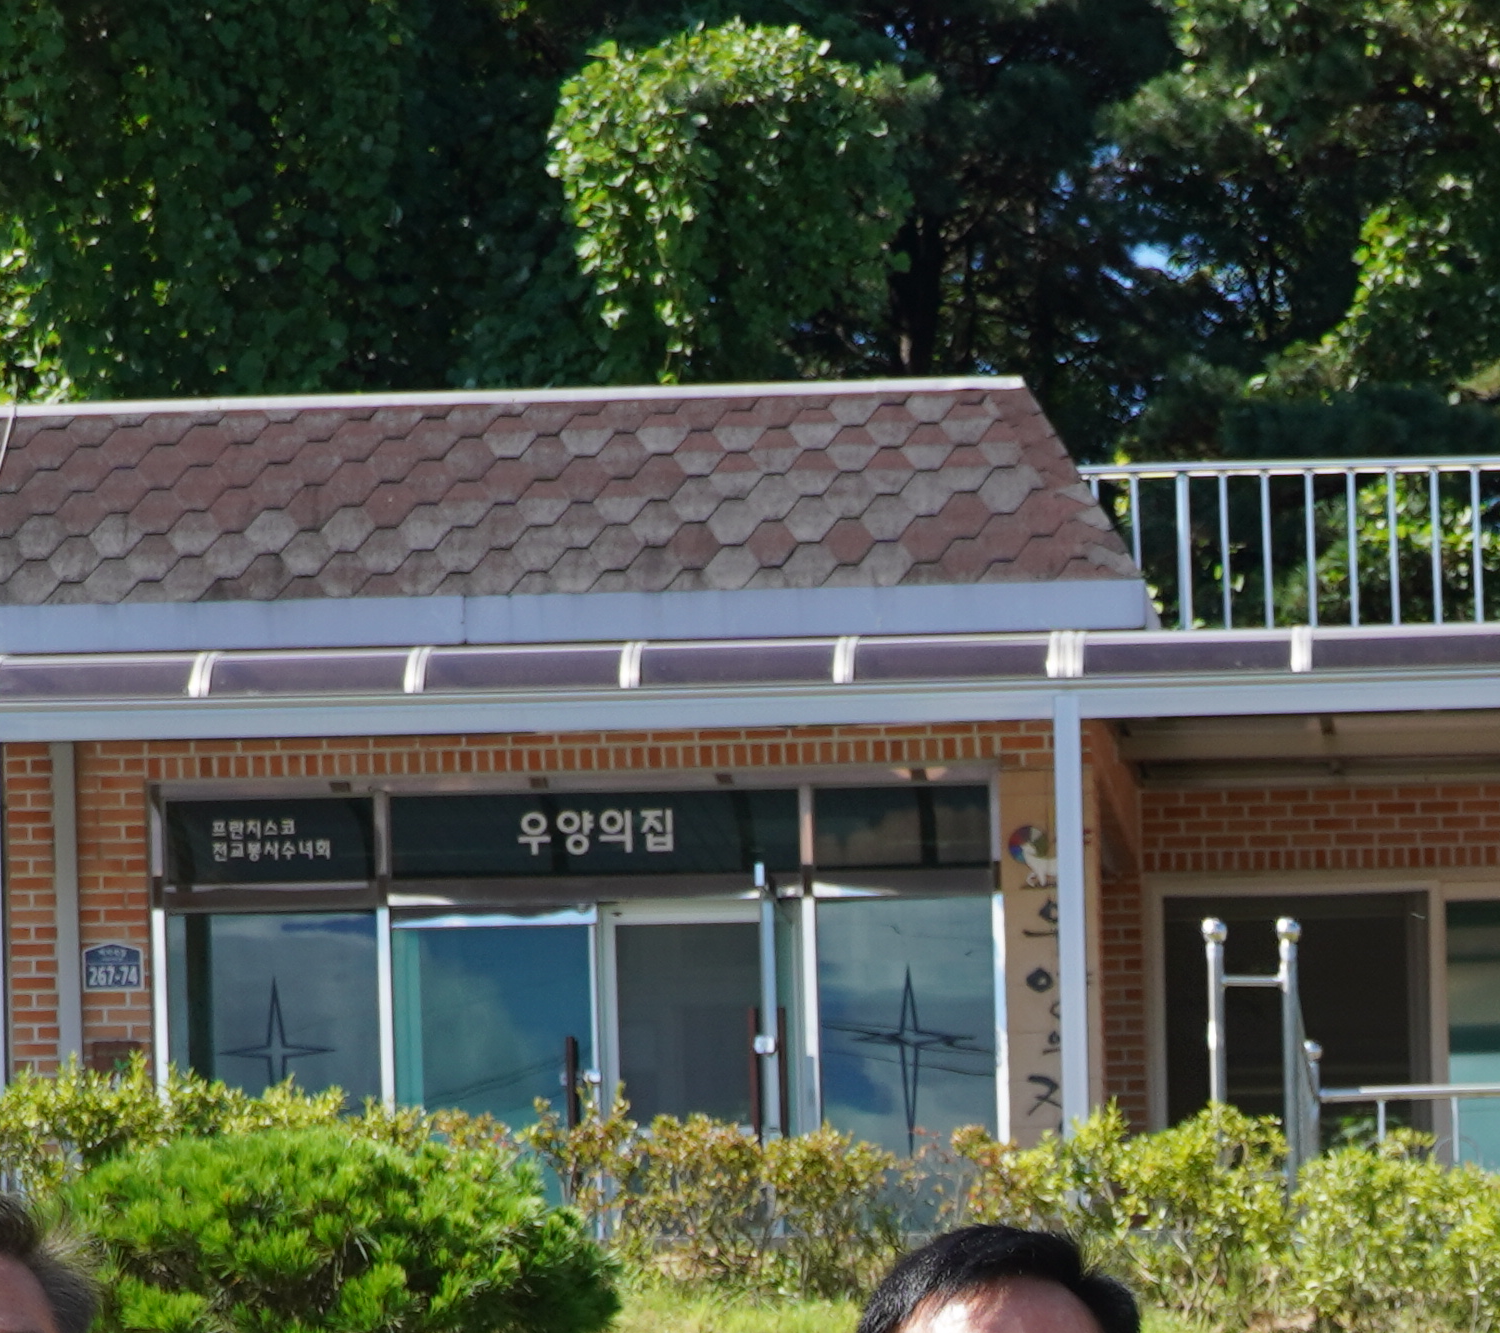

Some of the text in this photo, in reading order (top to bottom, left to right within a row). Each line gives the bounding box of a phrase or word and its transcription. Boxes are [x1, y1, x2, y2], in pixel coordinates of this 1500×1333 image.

[211, 818, 297, 841] 프란치스코
[517, 808, 675, 857] 우양의집
[211, 839, 332, 863] 전교봉사수녀회
[88, 965, 139, 987] 267-74
